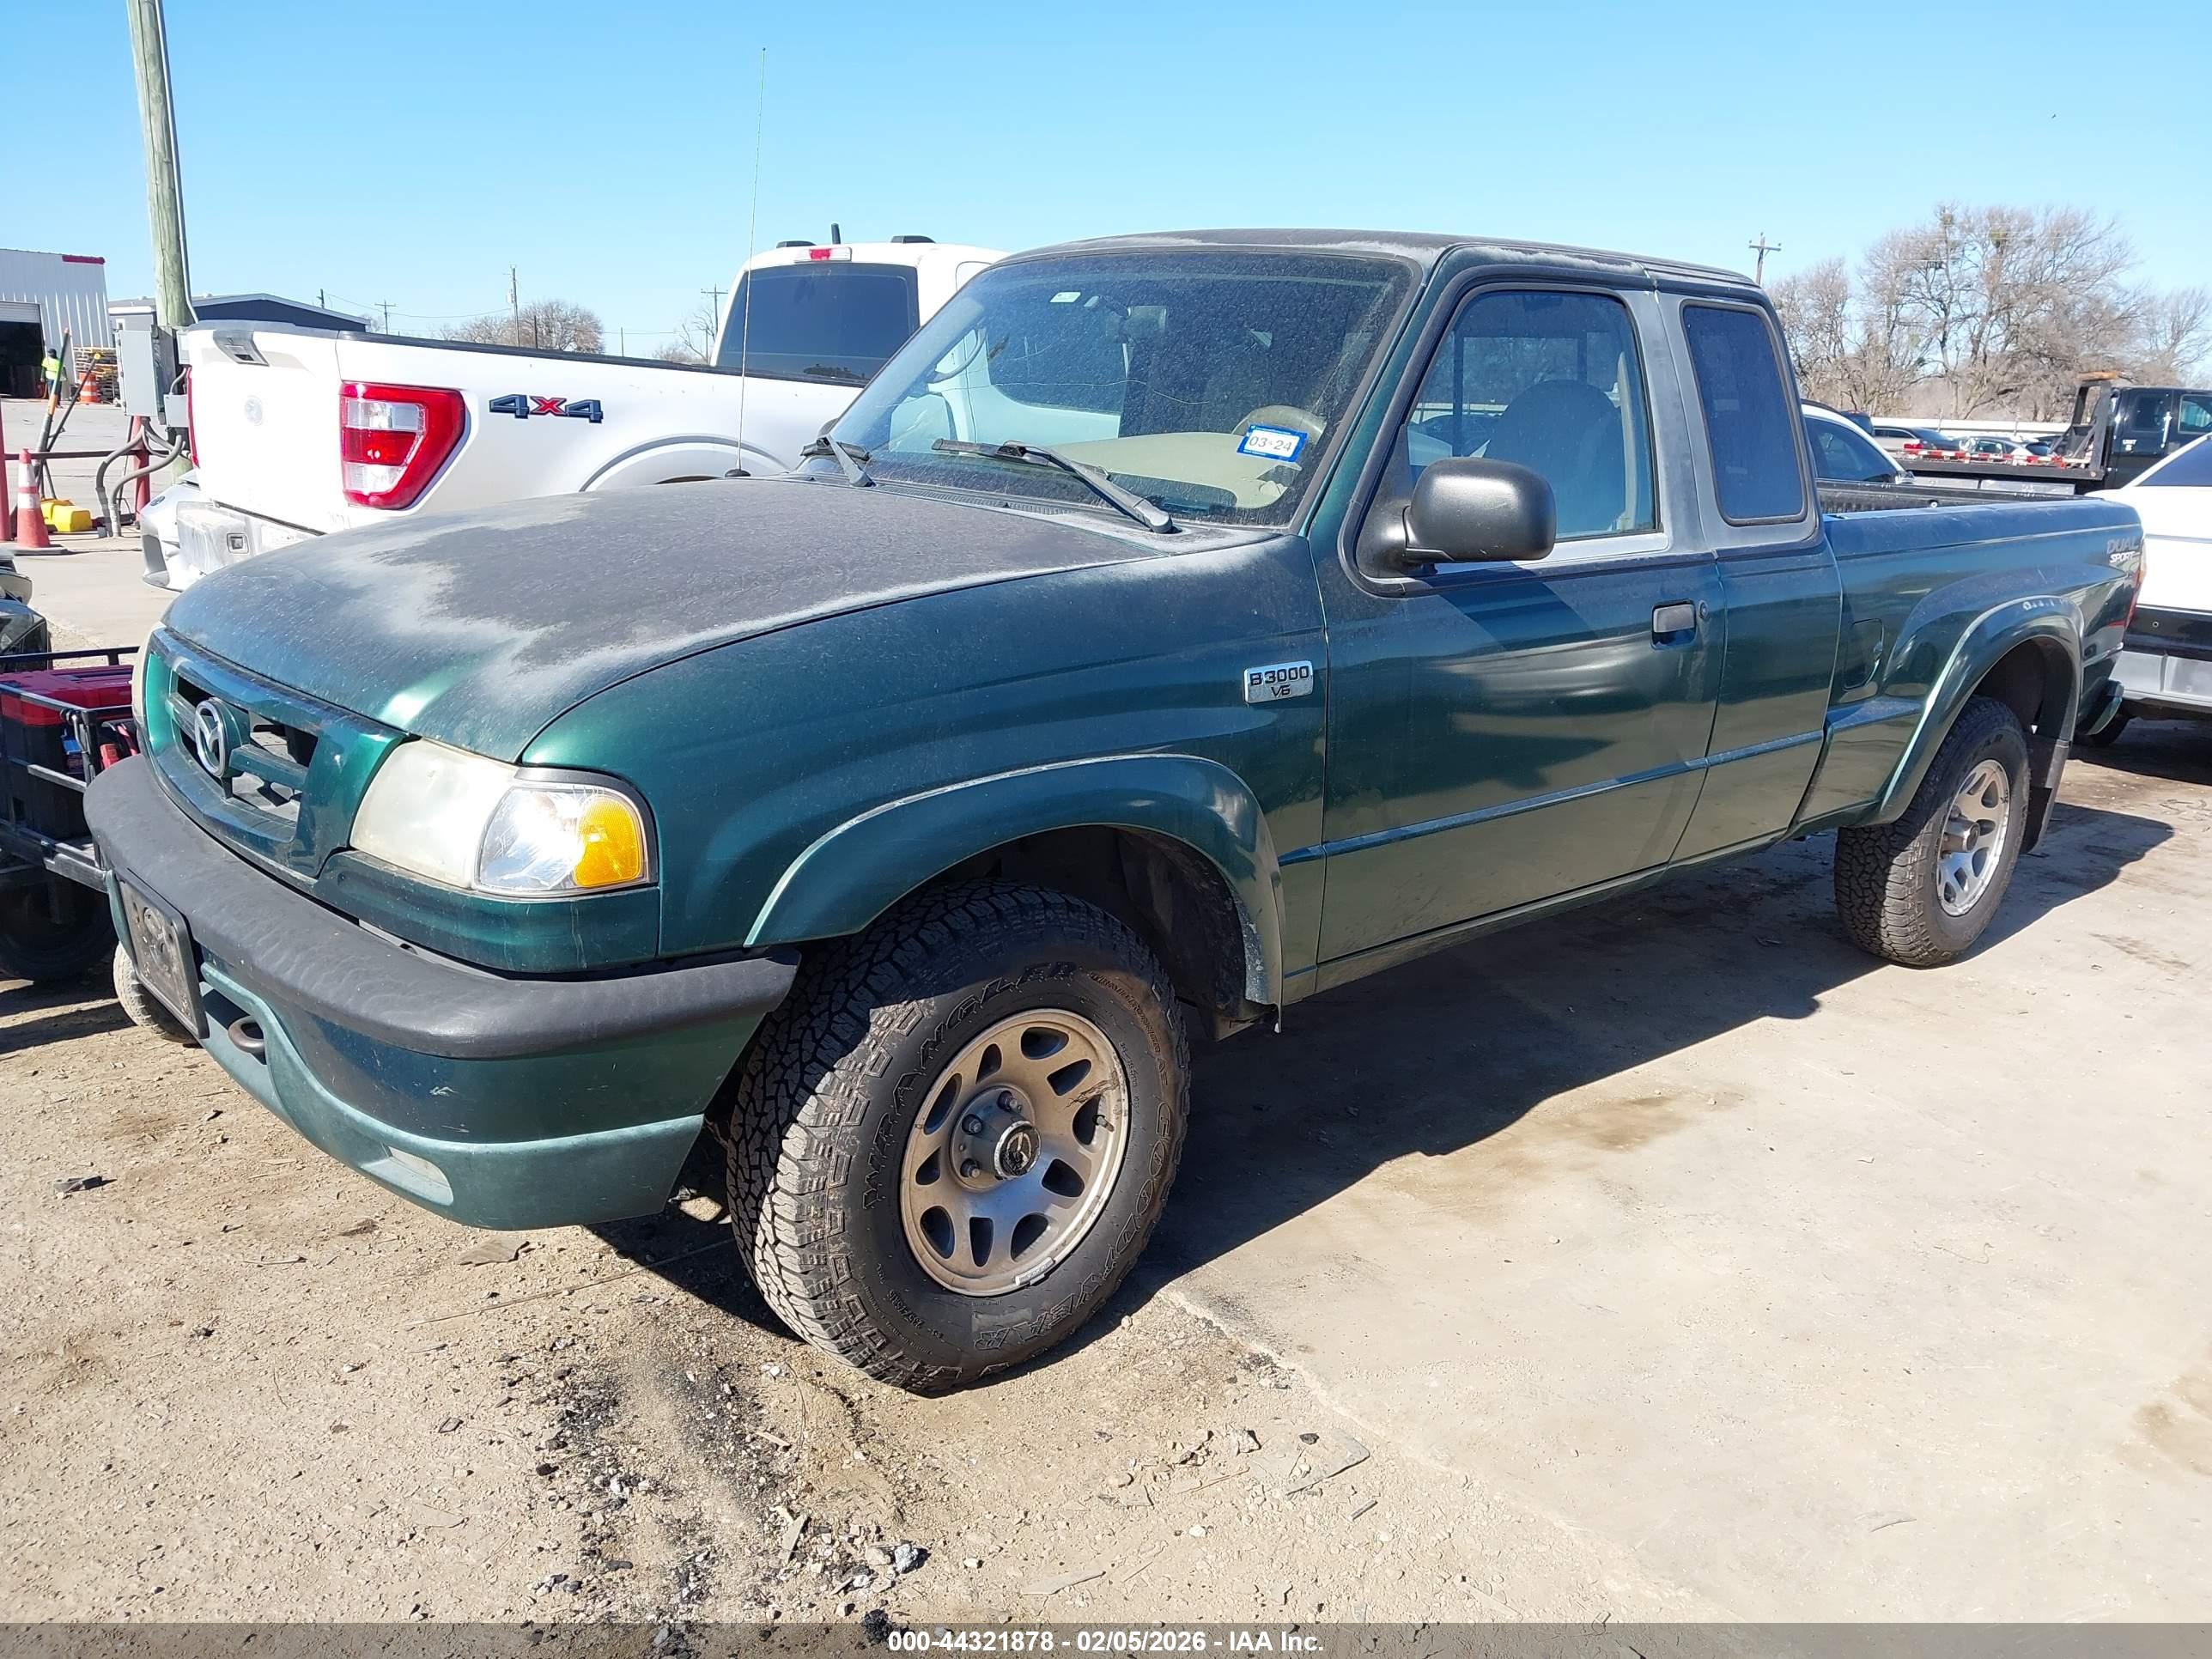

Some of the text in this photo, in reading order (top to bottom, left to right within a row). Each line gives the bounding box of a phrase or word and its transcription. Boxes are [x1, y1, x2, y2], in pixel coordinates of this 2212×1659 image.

[2106, 536, 2139, 554] DUAL
[2109, 550, 2140, 563] SPORT
[1249, 665, 1310, 686] B3000
[1271, 684, 1291, 697] V6
[862, 960, 1079, 1210] WRANGLER
[973, 1101, 1171, 1350] GOODYEAR
